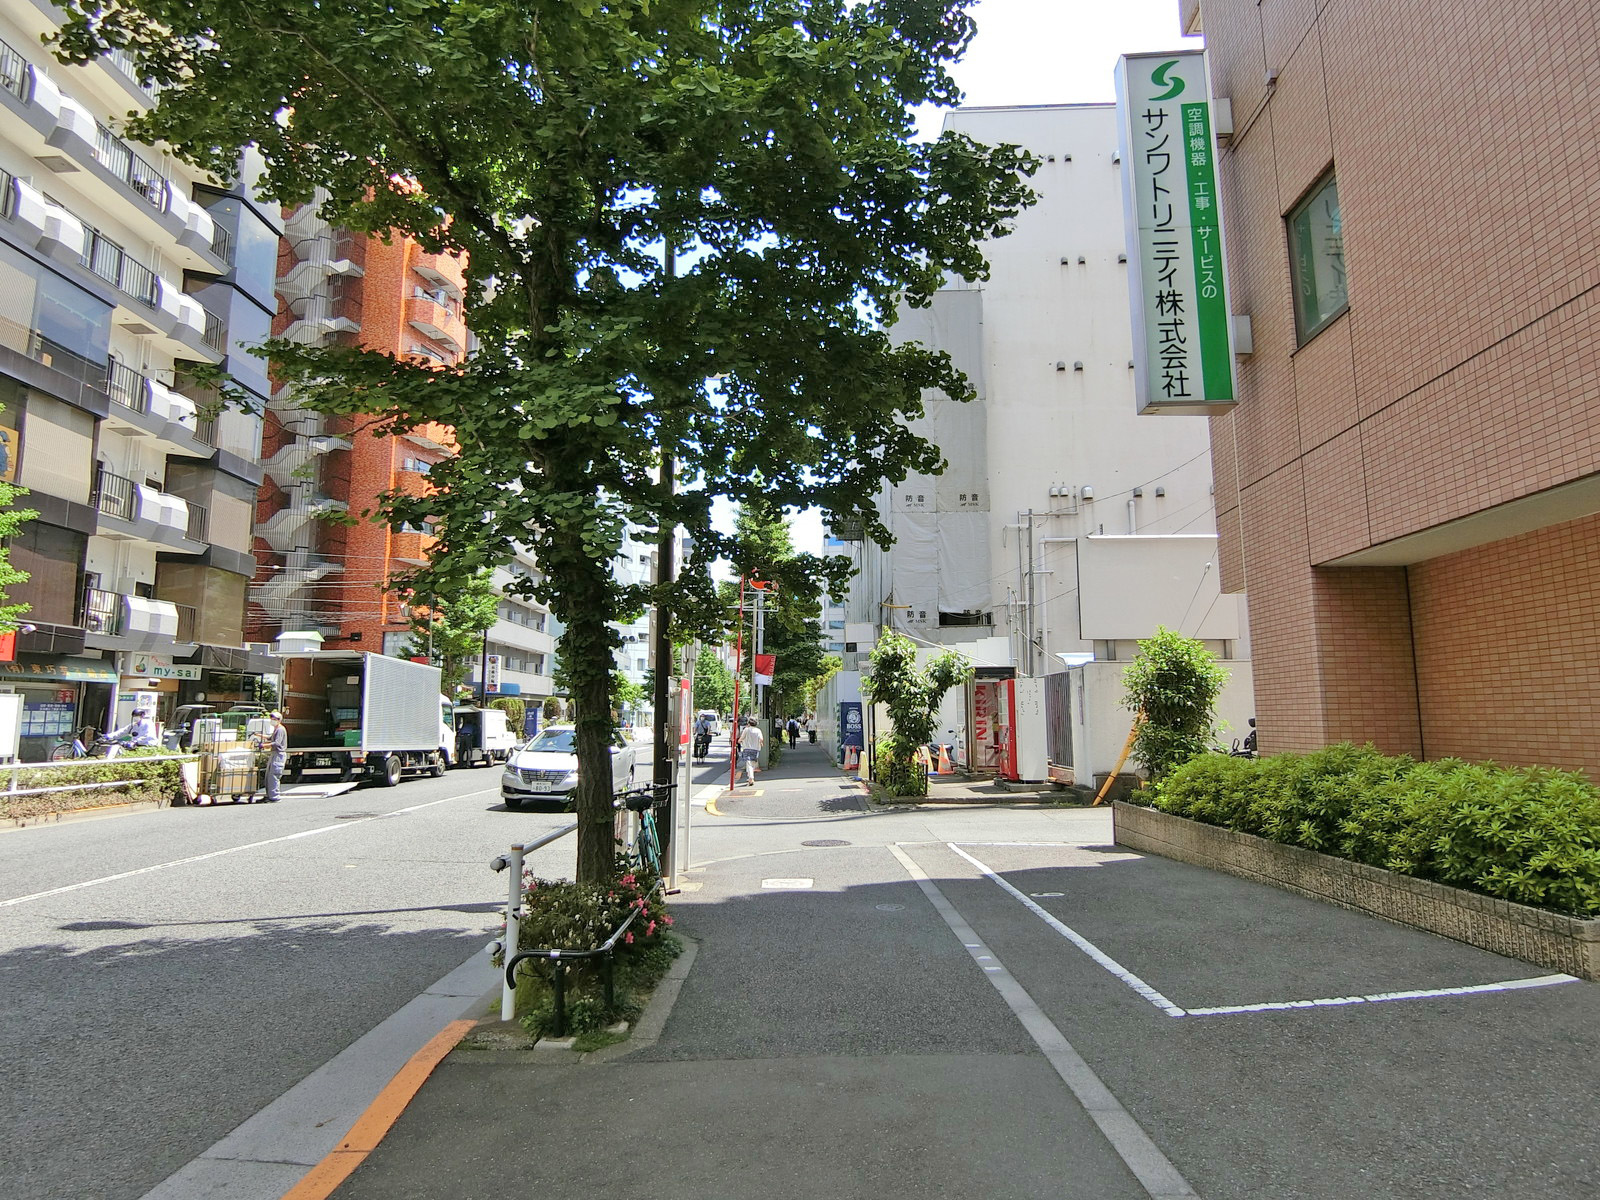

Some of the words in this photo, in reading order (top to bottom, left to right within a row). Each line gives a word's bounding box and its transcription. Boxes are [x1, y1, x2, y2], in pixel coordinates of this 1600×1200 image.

[1188, 108, 1217, 298] 空調機器・工事・サービスの
[1142, 108, 1191, 397] サンワトリニティ株式会社
[959, 493, 979, 501] 防音
[907, 610, 927, 618] 防音
[153, 667, 198, 678] my-sai
[975, 685, 987, 740] KIRIN
